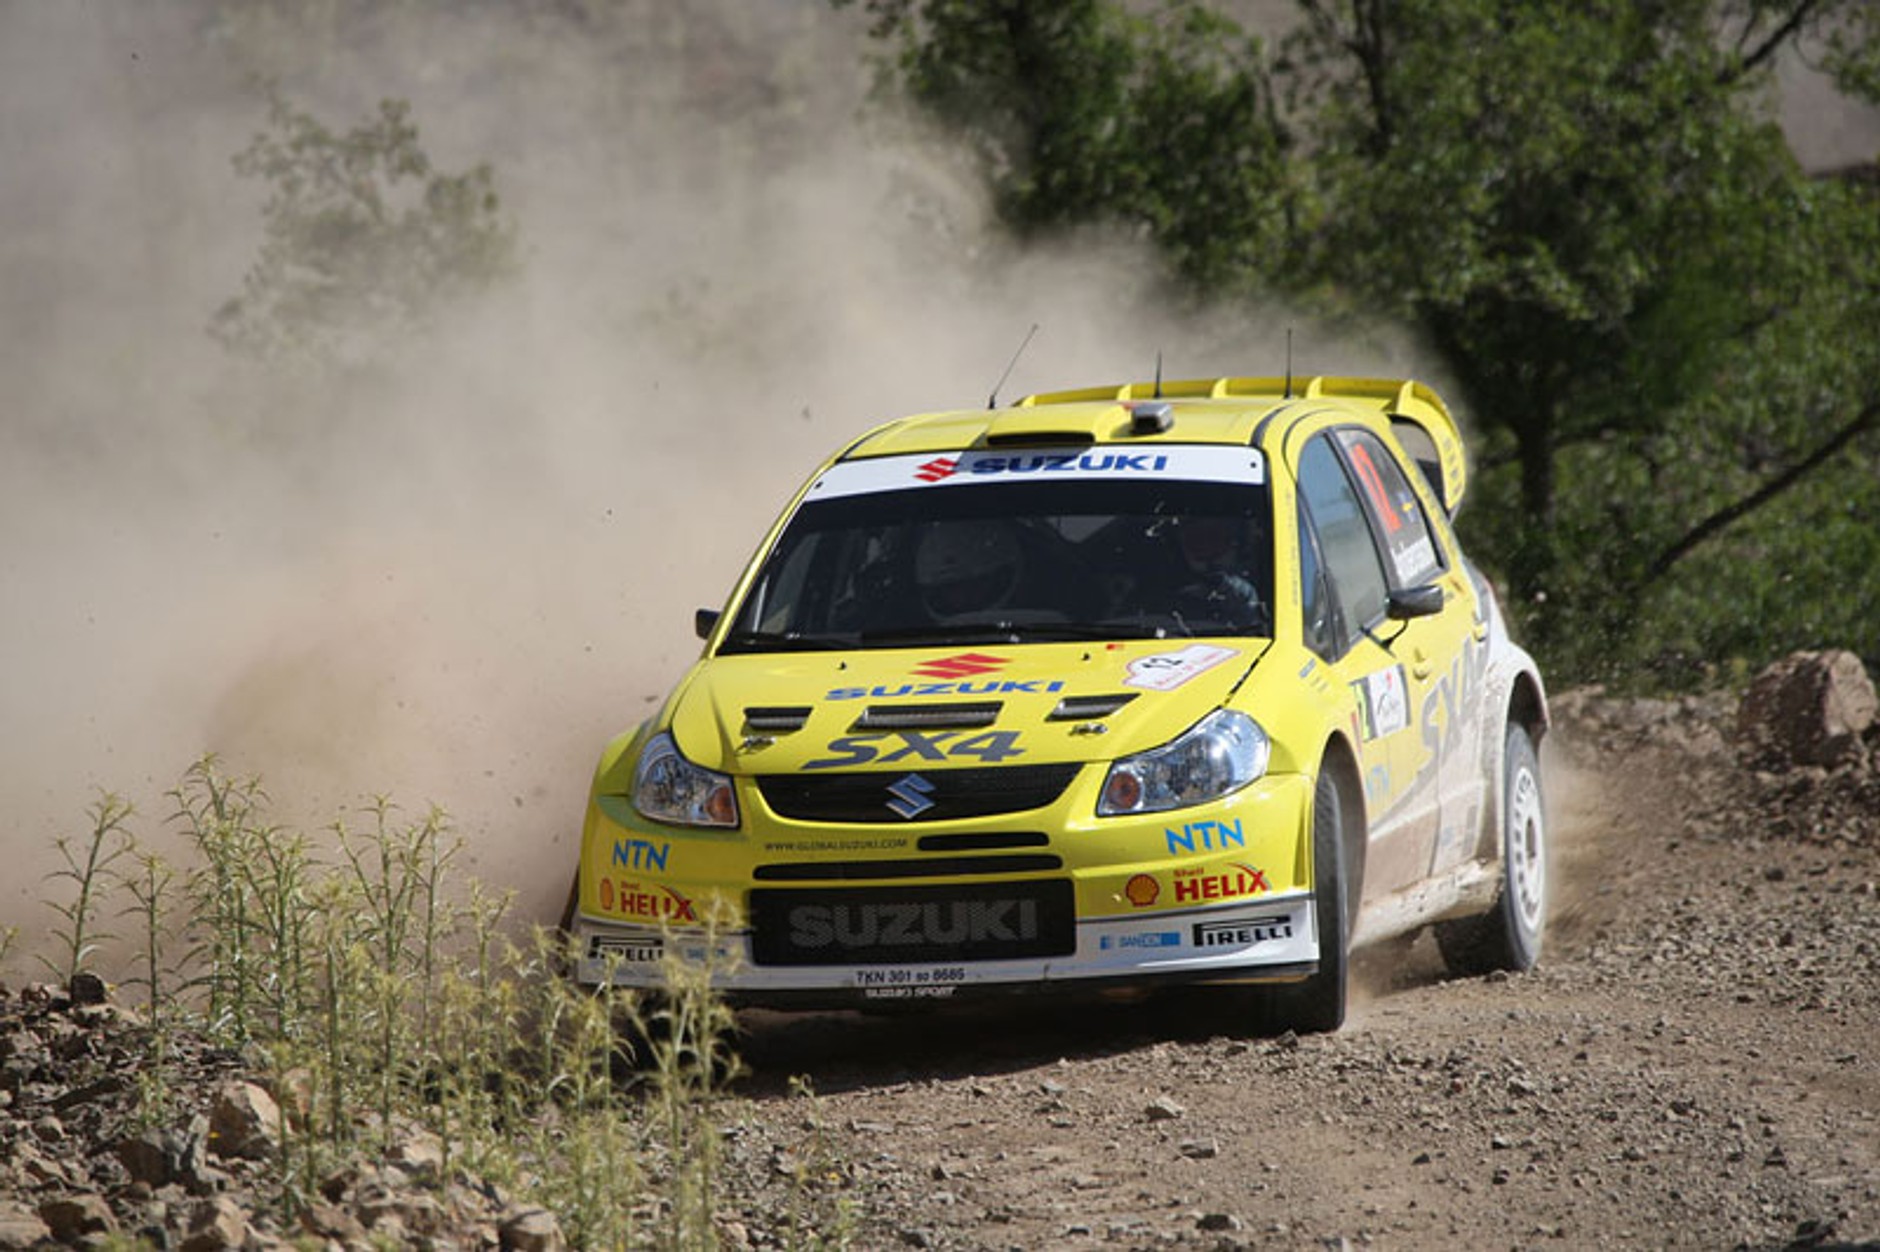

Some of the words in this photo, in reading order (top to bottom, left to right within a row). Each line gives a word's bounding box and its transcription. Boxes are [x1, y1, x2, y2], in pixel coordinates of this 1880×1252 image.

[971, 455, 1168, 475] SUZUKI
[824, 680, 1065, 701] SUZUKI
[801, 730, 1027, 770] SX4
[1165, 818, 1245, 855] NTN
[612, 839, 670, 872] NTN
[1174, 865, 1271, 902] HELIX
[620, 884, 699, 922] HELIX
[789, 899, 1037, 948] SUZUKI
[1192, 914, 1293, 948] PIRELLI
[856, 969, 886, 984] TKN
[888, 969, 912, 982] 301
